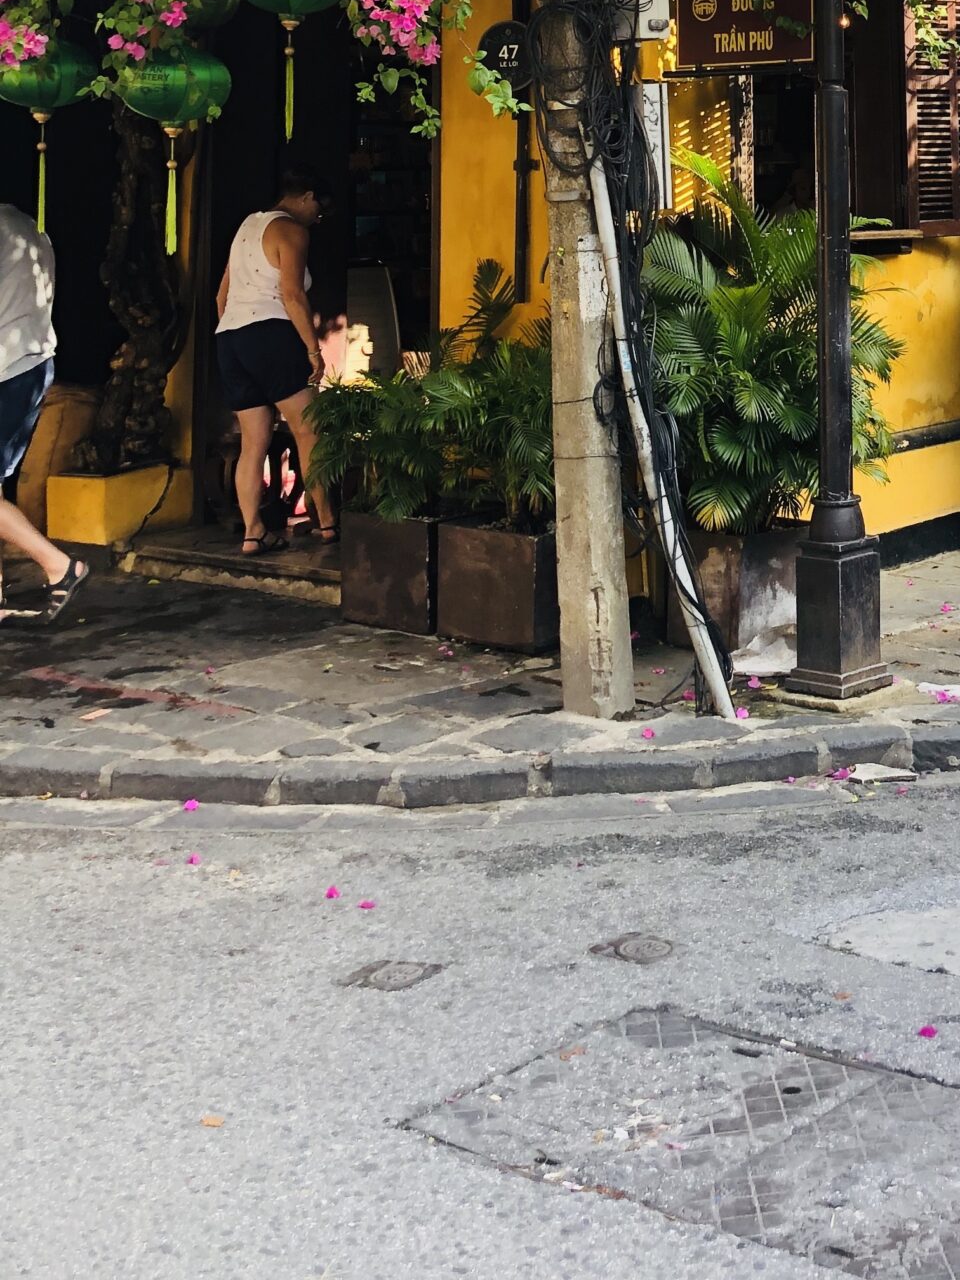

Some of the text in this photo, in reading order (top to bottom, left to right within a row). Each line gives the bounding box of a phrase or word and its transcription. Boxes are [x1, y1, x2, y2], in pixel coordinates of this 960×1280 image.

[713, 24, 774, 53] TRẦN PHÚ
[498, 44, 519, 60] 47
